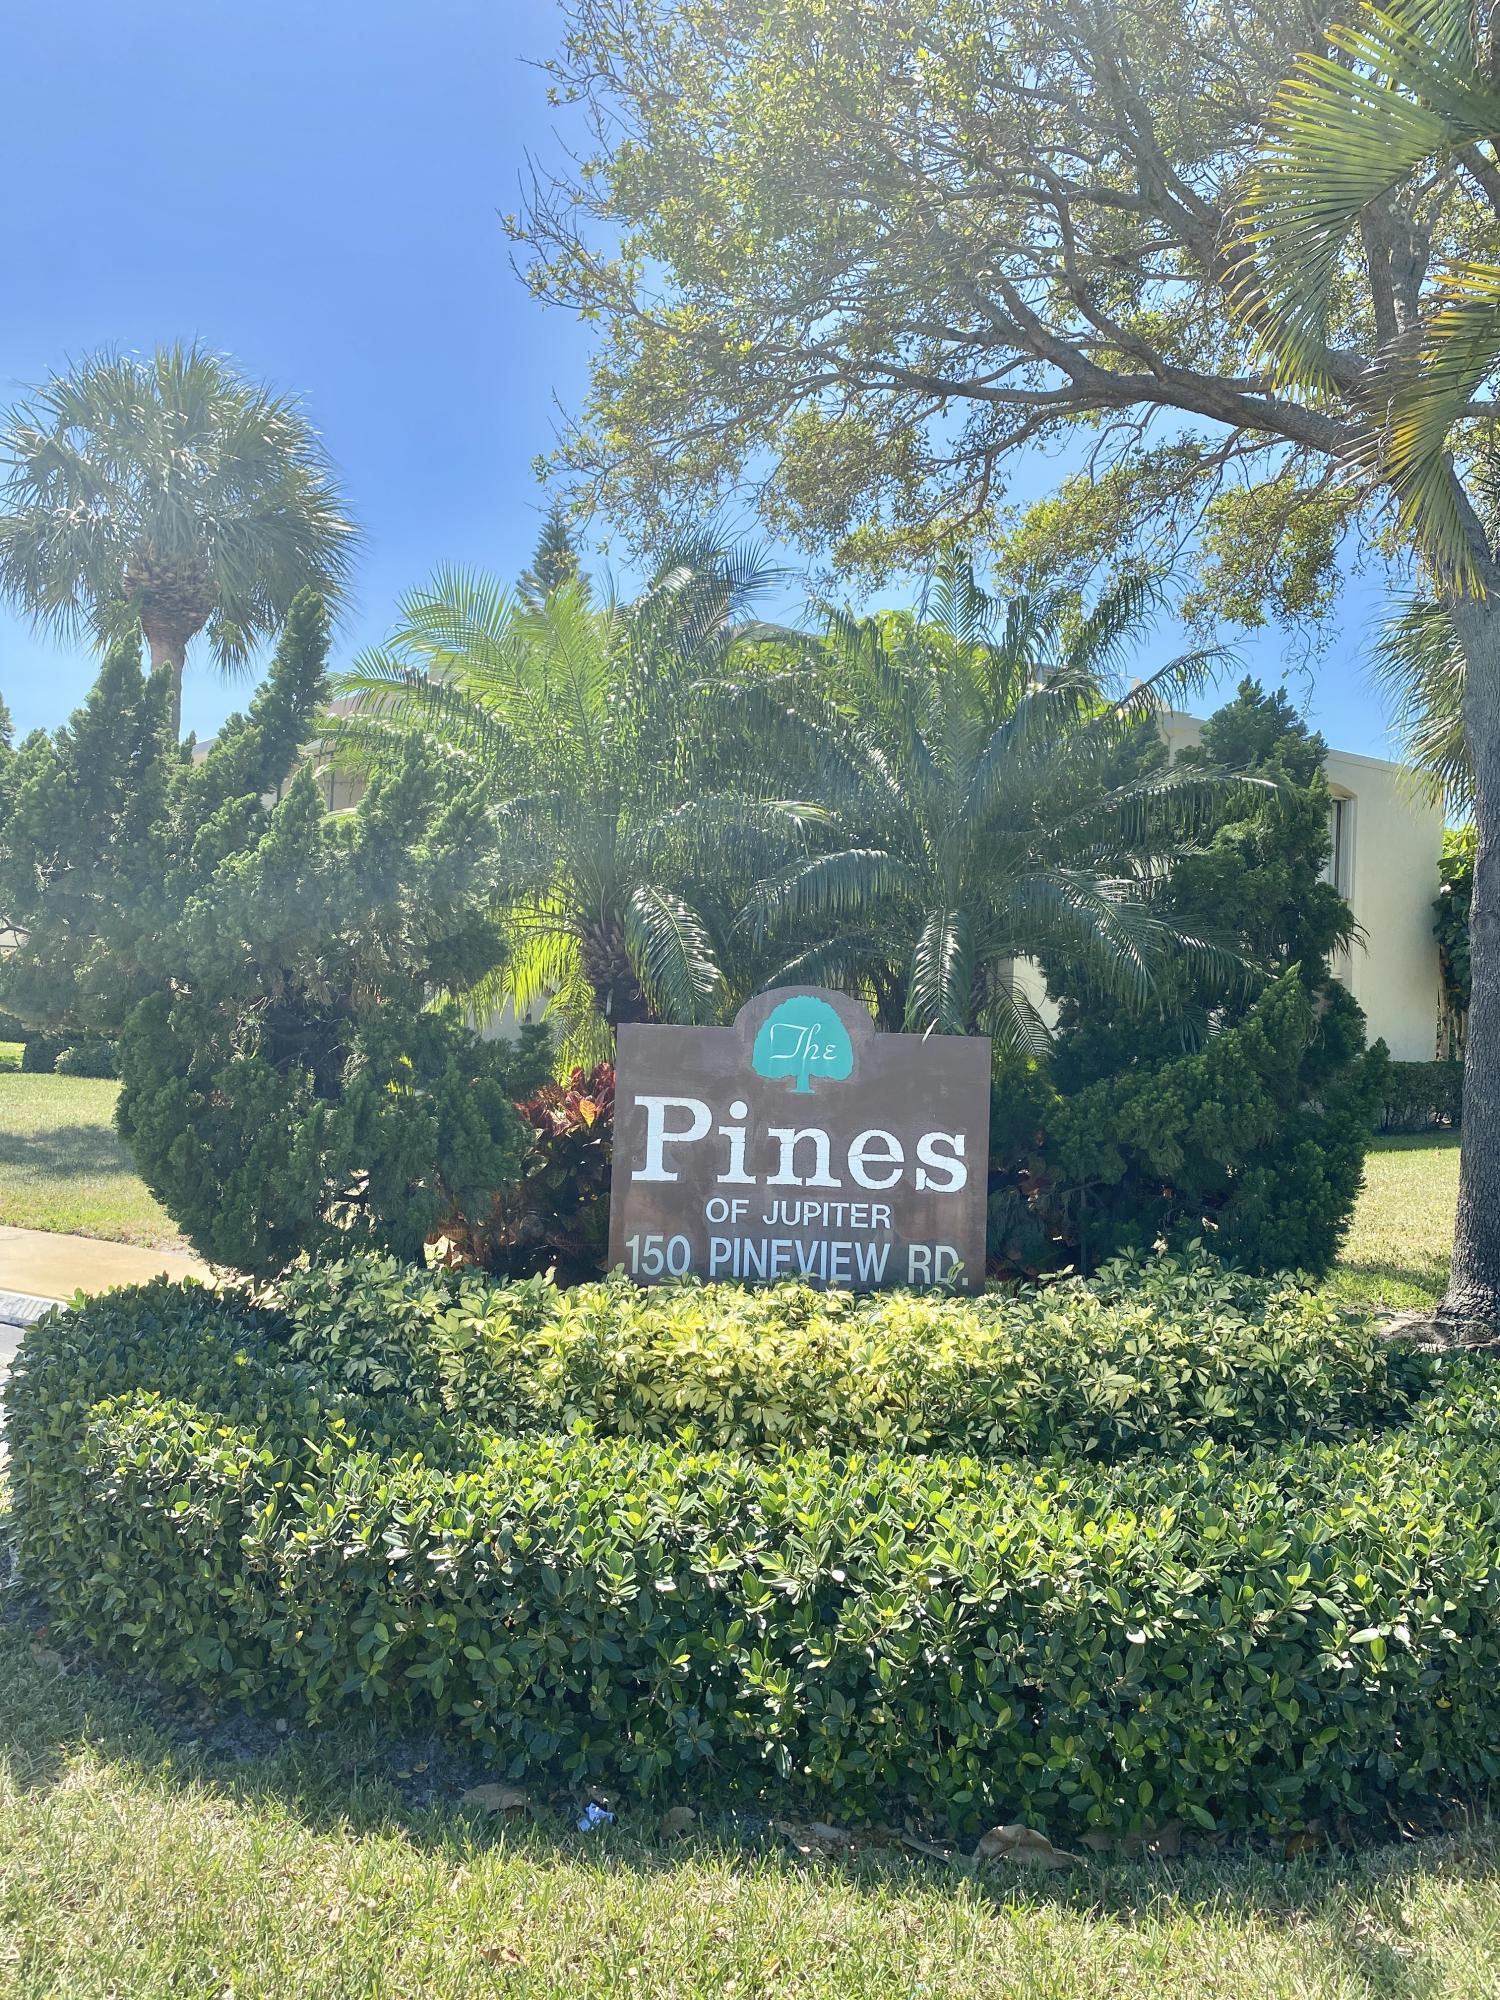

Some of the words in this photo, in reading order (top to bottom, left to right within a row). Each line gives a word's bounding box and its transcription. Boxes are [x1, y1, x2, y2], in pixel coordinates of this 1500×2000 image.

[769, 1023, 837, 1060] The
[631, 1095, 968, 1193] Pines
[705, 1197, 750, 1224] OF
[762, 1200, 891, 1229] JUPITER
[625, 1234, 691, 1277] 150
[709, 1236, 891, 1283] PINEVIEW
[907, 1244, 969, 1286] RD.
